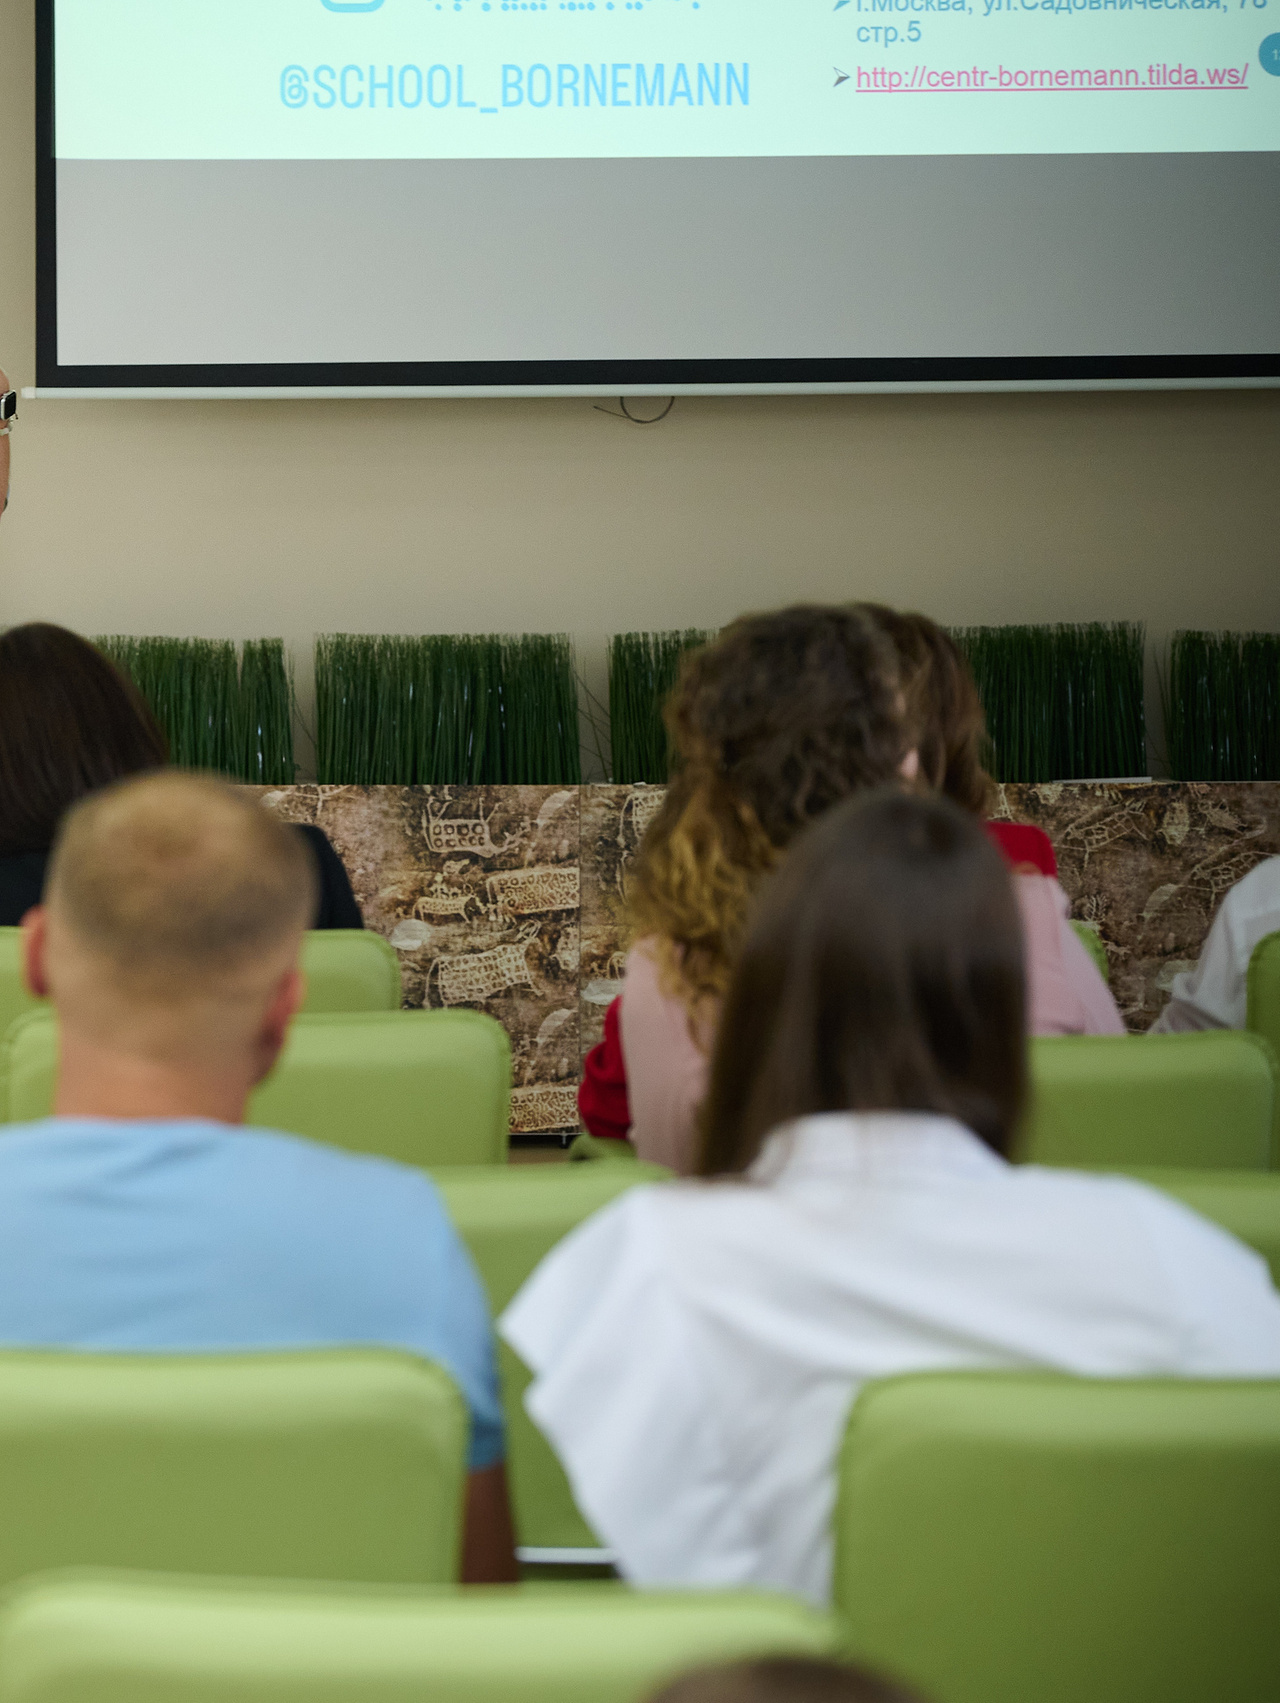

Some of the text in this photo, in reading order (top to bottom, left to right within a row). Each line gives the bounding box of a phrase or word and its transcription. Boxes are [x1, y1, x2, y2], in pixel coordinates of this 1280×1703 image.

[856, 20, 921, 48] стр.5
[279, 62, 751, 113] @SCHOOL_BORNEMANN
[855, 63, 1249, 93] http://centr-bornemann.tilda.ws/
